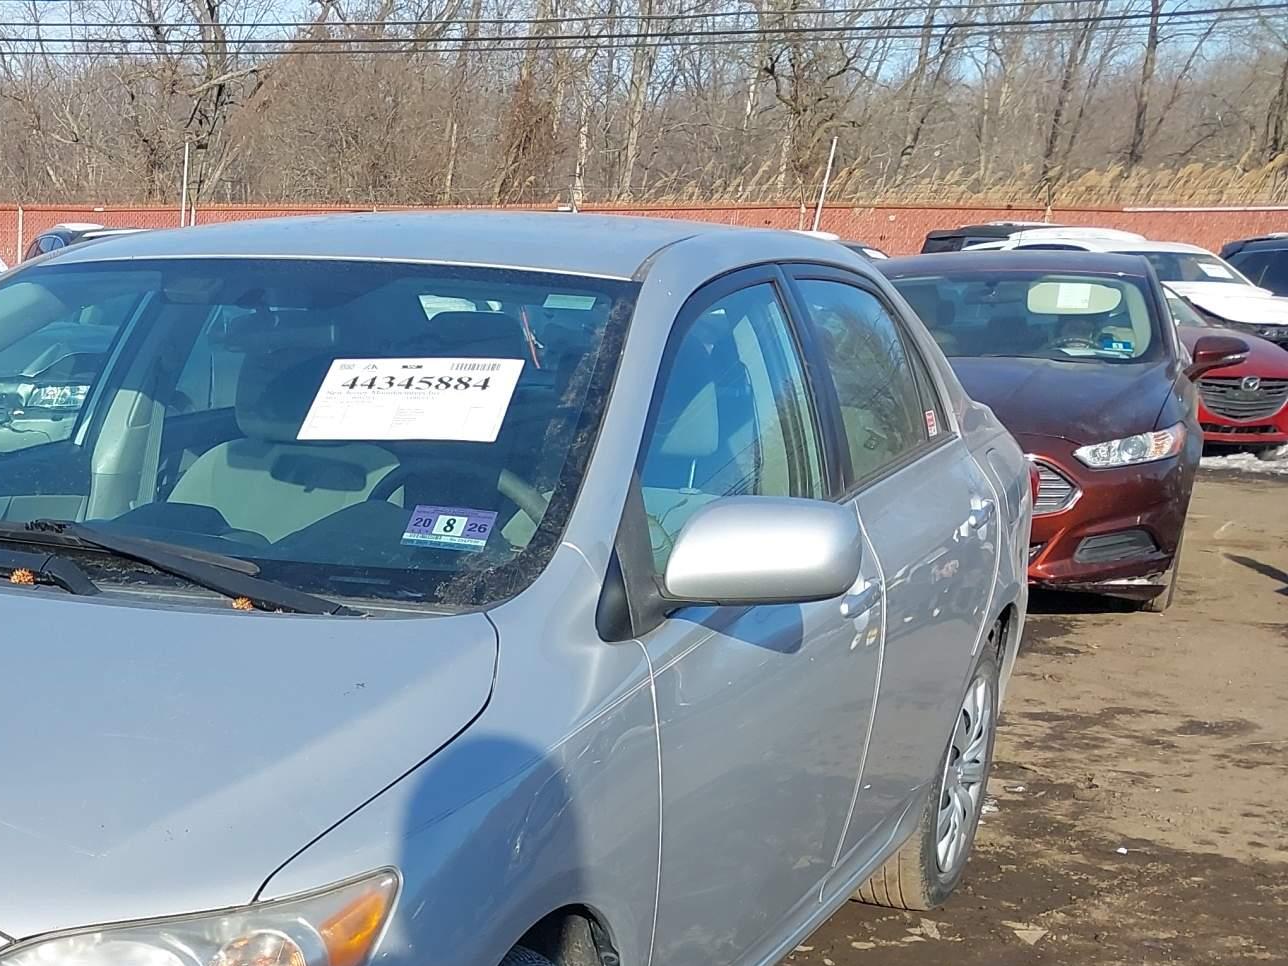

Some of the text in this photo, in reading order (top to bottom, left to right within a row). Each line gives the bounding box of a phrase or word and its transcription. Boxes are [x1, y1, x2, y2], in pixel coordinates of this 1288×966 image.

[341, 376, 491, 391] 44345884
[413, 517, 488, 533] 20 8 26
